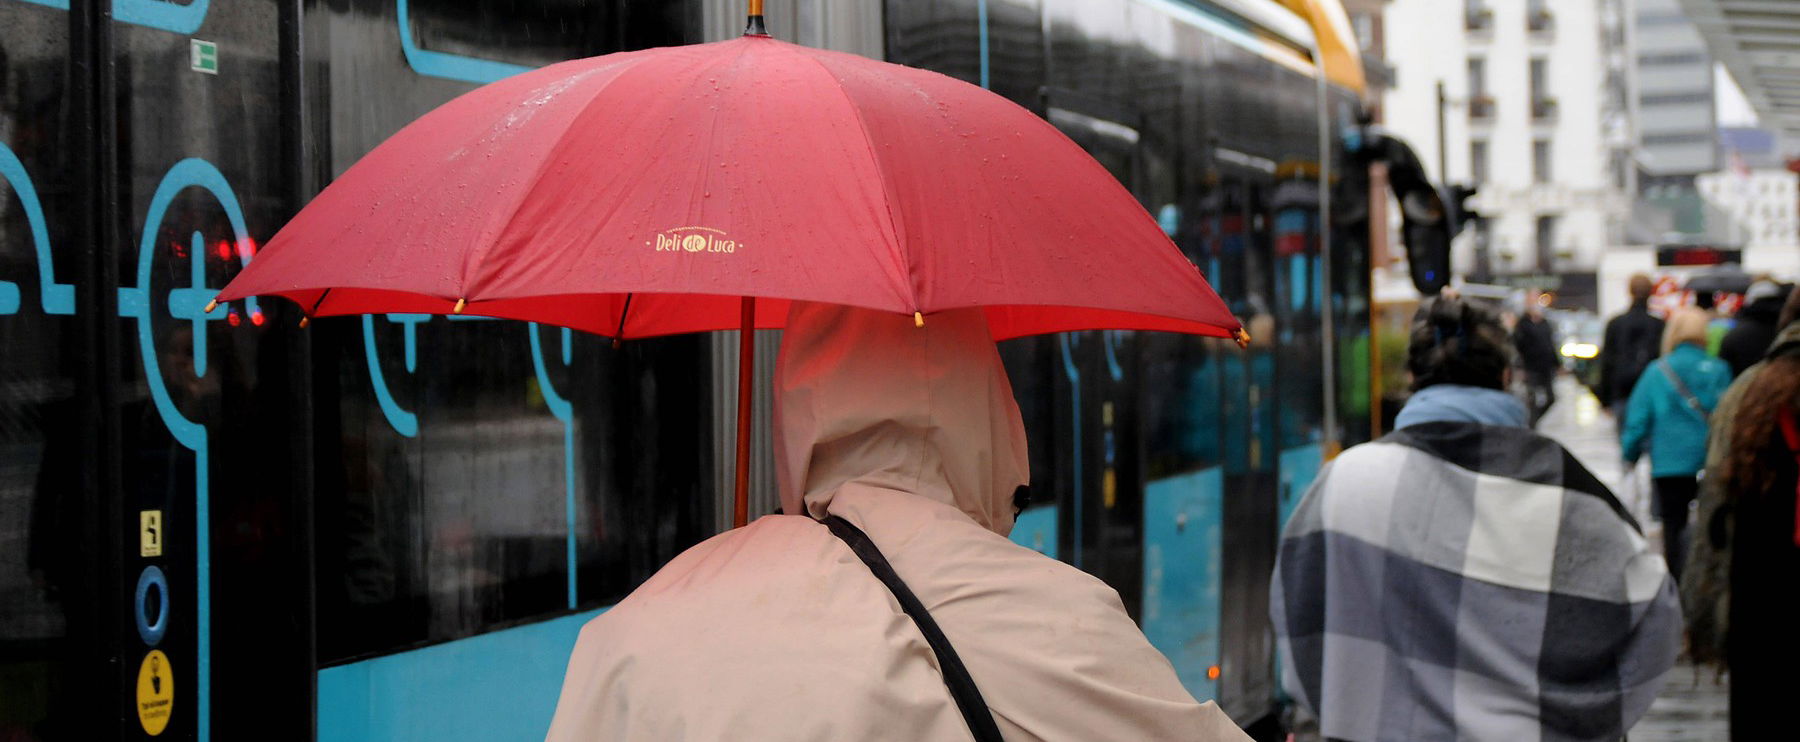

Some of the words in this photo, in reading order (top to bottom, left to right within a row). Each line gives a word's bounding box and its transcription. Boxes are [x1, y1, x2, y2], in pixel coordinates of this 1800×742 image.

[656, 233, 682, 252] Deli
[684, 234, 705, 252] de
[707, 234, 736, 253] Luca
